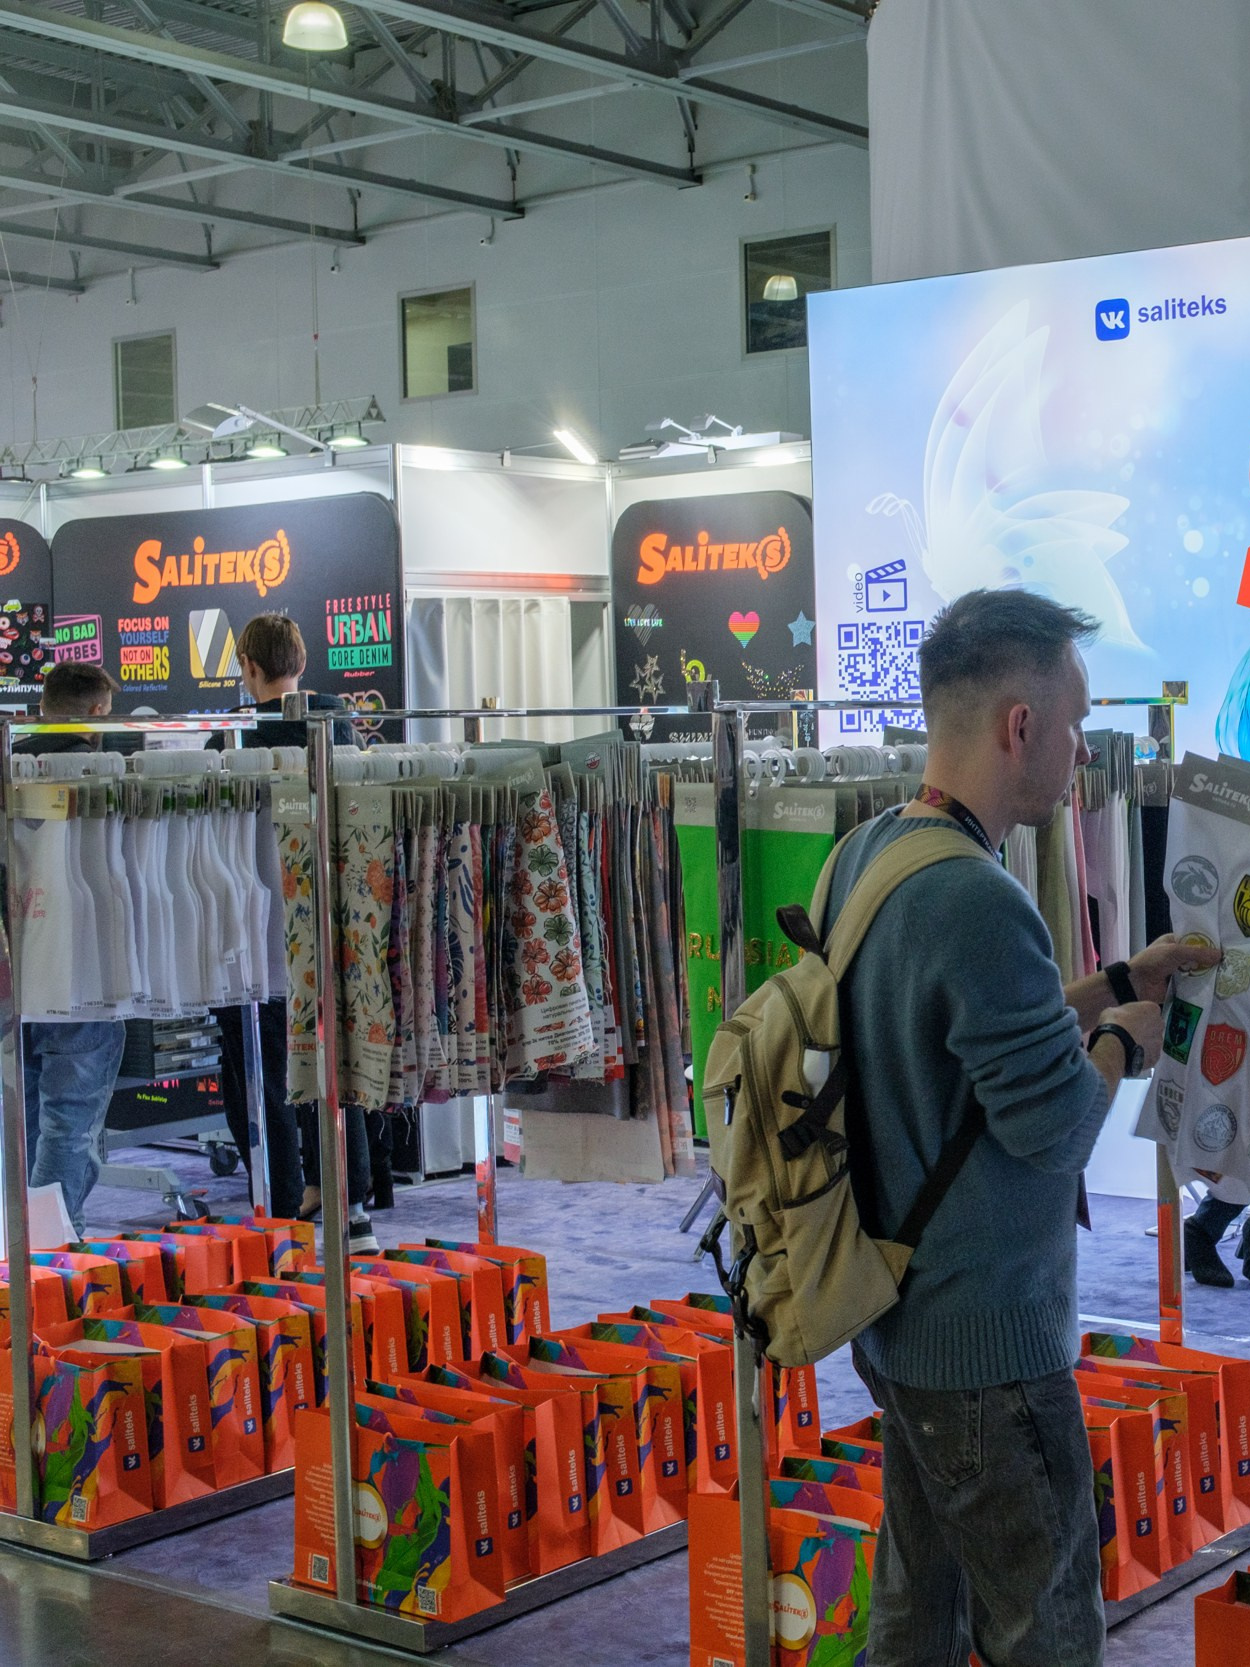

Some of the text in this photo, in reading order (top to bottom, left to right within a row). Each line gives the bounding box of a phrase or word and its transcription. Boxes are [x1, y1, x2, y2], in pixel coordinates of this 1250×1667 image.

[1137, 294, 1227, 324] saliteks
[325, 593, 391, 614] FREESTYLE
[853, 572, 864, 614] video
[55, 623, 96, 644] NO BAD
[117, 616, 170, 633] FOCUS ON
[120, 631, 170, 646] YOURSELF
[326, 609, 392, 646] URBAN
[58, 643, 98, 661] VIBES
[120, 646, 170, 681] OTHERS
[123, 649, 151, 663] NOT ON
[331, 648, 389, 666] CORE DENIM
[488, 1313, 498, 1349] saliteks
[533, 1300, 542, 1335] saliteks
[388, 1337, 398, 1373] saliteks
[443, 1325, 453, 1361] saliteks
[243, 1376, 253, 1415] saliteks
[296, 1362, 305, 1400] saliteks
[797, 1369, 807, 1408] saliteks
[126, 1410, 137, 1451] saliteks
[188, 1394, 201, 1433] saliteks
[715, 1401, 726, 1442] saliteks
[615, 1433, 628, 1476] saliteks
[663, 1416, 674, 1457] saliteks
[1200, 1431, 1210, 1474] saliteks
[1238, 1415, 1248, 1456] saliteks
[509, 1464, 518, 1508] saliteks
[567, 1449, 579, 1492] saliteks
[1173, 1450, 1183, 1493] saliteks
[1137, 1471, 1146, 1515] saliteks
[477, 1490, 488, 1535] saliteks
